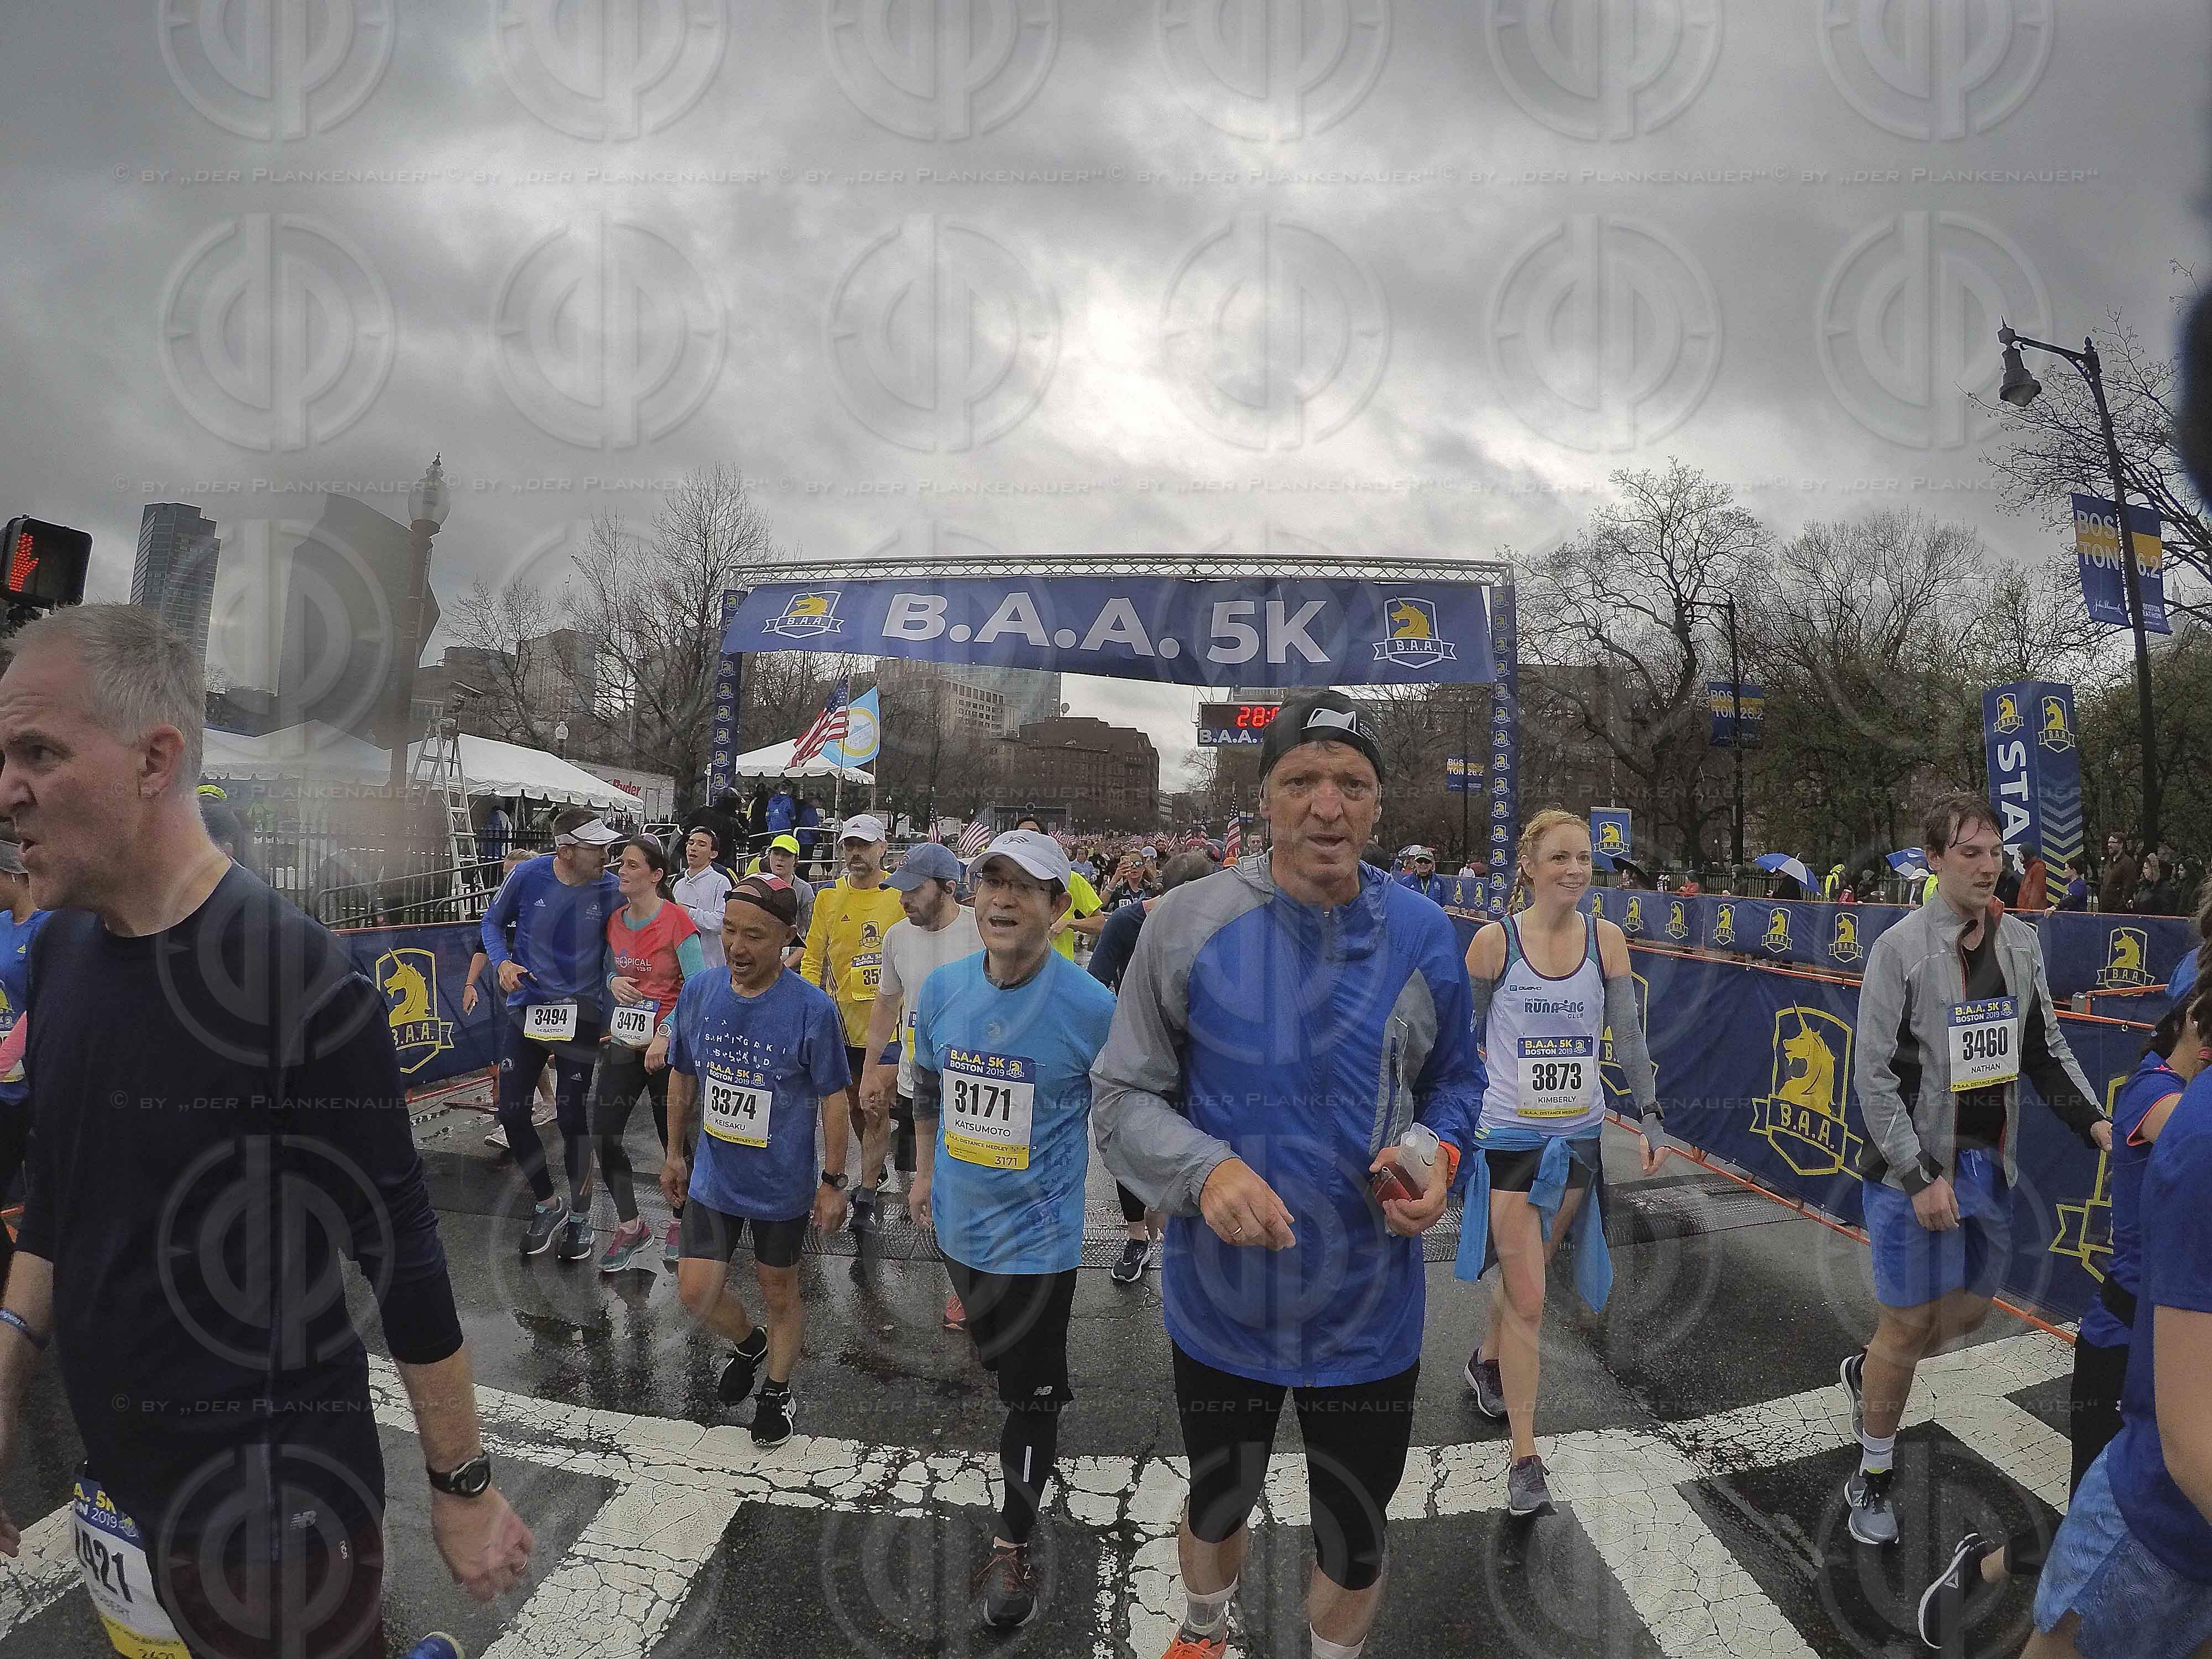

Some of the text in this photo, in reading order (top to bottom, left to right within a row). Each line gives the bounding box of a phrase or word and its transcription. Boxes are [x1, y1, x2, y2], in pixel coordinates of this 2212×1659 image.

[2077, 510, 2116, 540] BOS
[2078, 541, 2160, 579] TON 6.2
[786, 615, 825, 626] B.A.A.
[881, 592, 1332, 664] B.A.A. 5K
[1395, 639, 1438, 653] B.A.A.
[1710, 690, 1734, 703] BOS
[1713, 705, 1735, 718] TON
[1199, 729, 1258, 744] B.A.A.
[1448, 758, 1464, 766] BOS
[863, 968, 881, 985] 35
[2112, 968, 2141, 982] B.A.A.
[1955, 1001, 1999, 1015] B.A.A. 5K
[534, 1008, 568, 1026] 3494
[617, 1010, 646, 1032] 3478
[1956, 1011, 2000, 1023] BOSTON 2019
[1525, 1039, 1573, 1049] B.A.A. 5K
[1963, 1026, 2008, 1061] 3460
[950, 1048, 1005, 1068] B.A.A. 5K
[709, 1061, 734, 1076] B.A.A.
[736, 1068, 750, 1079] 5K
[950, 1060, 1005, 1076] BOSTON 2019
[1971, 1063, 2001, 1074] NATHAN
[709, 1069, 750, 1086] BOSTON 2019
[1532, 1063, 1582, 1091] 3873
[711, 1084, 757, 1120] 3374
[954, 1079, 1011, 1122] 3171
[714, 1118, 746, 1131] KEISAKU
[954, 1118, 1011, 1138] KATSUMOTO
[1779, 1103, 1835, 1150] B.A.A.
[959, 1138, 985, 1148] DISTANCE
[985, 1143, 1009, 1152] MEDLEY
[994, 1156, 1018, 1167] 3171
[91, 1507, 118, 1529] 2019
